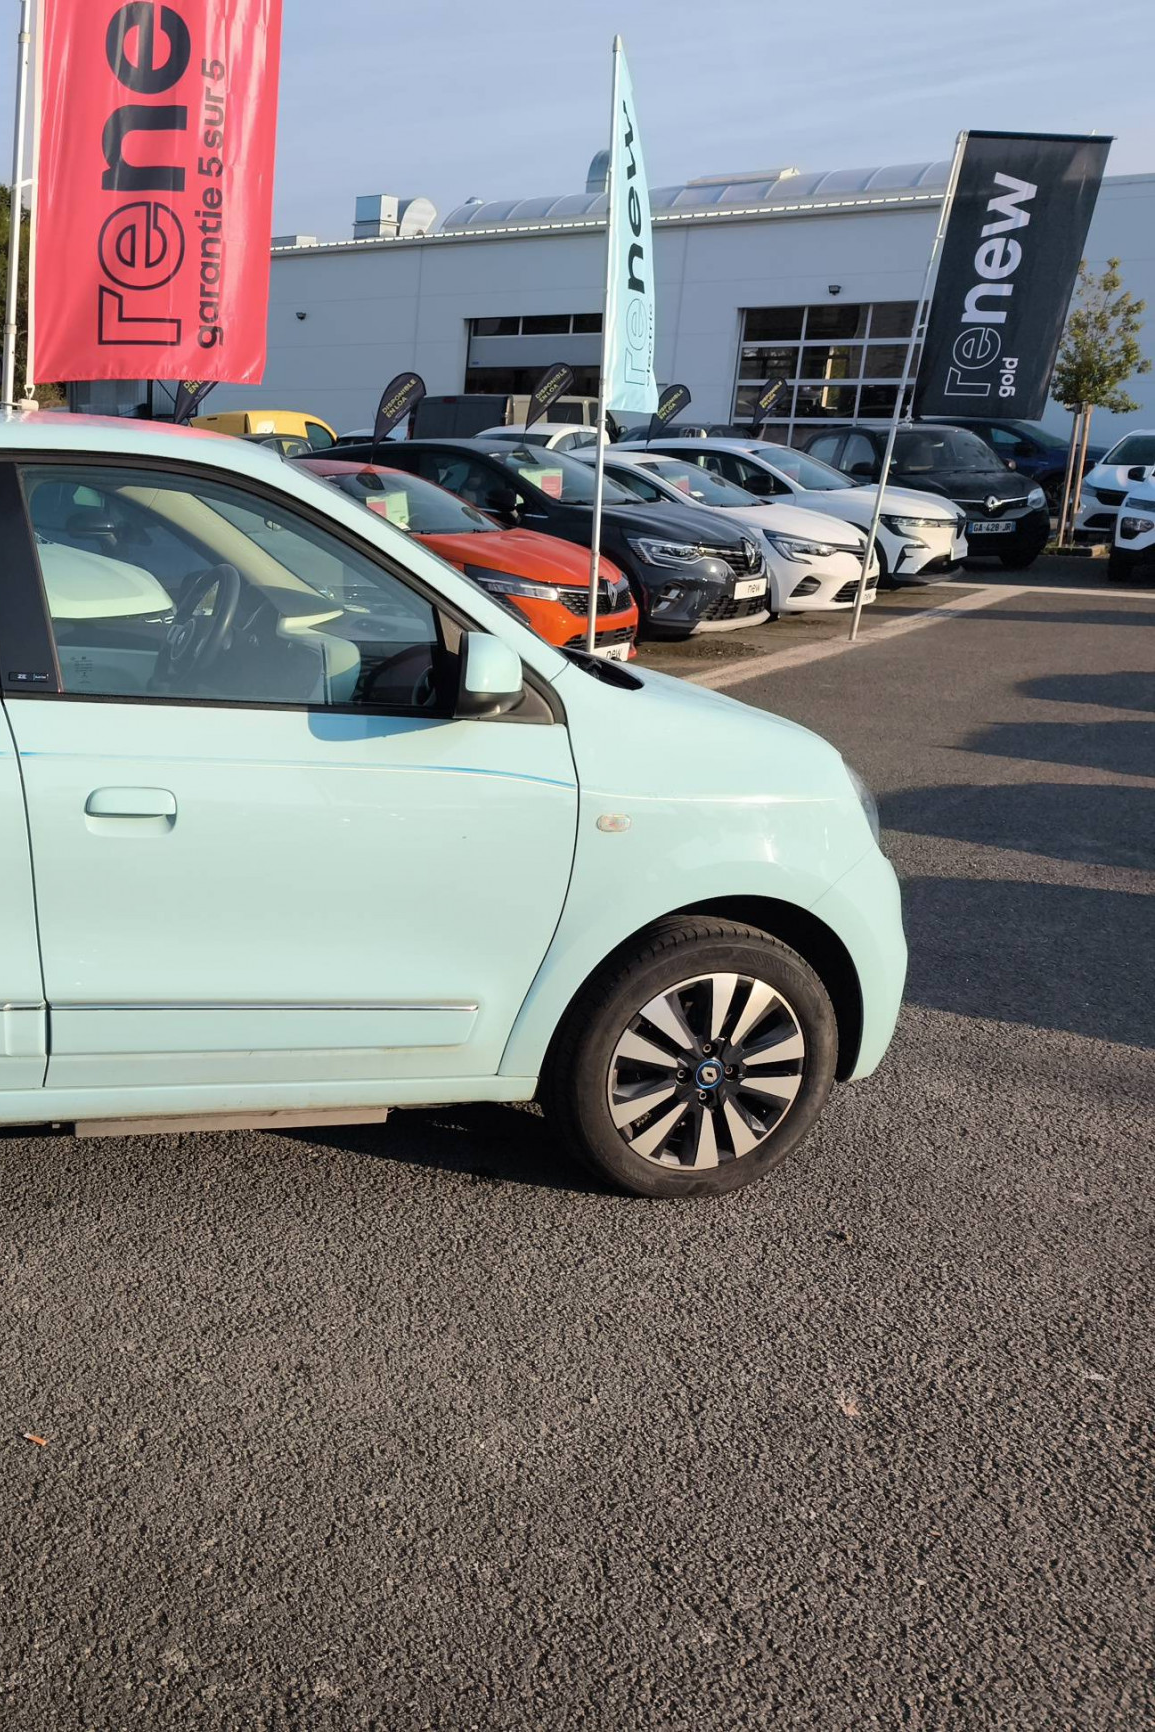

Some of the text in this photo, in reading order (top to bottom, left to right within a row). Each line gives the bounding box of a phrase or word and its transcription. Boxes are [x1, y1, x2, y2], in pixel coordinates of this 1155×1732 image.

[194, 58, 226, 350] garantie 5 sur 5
[622, 99, 646, 386] renew
[944, 171, 1039, 397] renew
[188, 382, 199, 394] EN
[535, 368, 567, 399] DISPONIBLE
[546, 384, 559, 395] LOA
[998, 357, 1019, 398] gold
[382, 379, 416, 413] DISPONIBLE
[386, 408, 396, 418] EN
[394, 397, 407, 410] LOA
